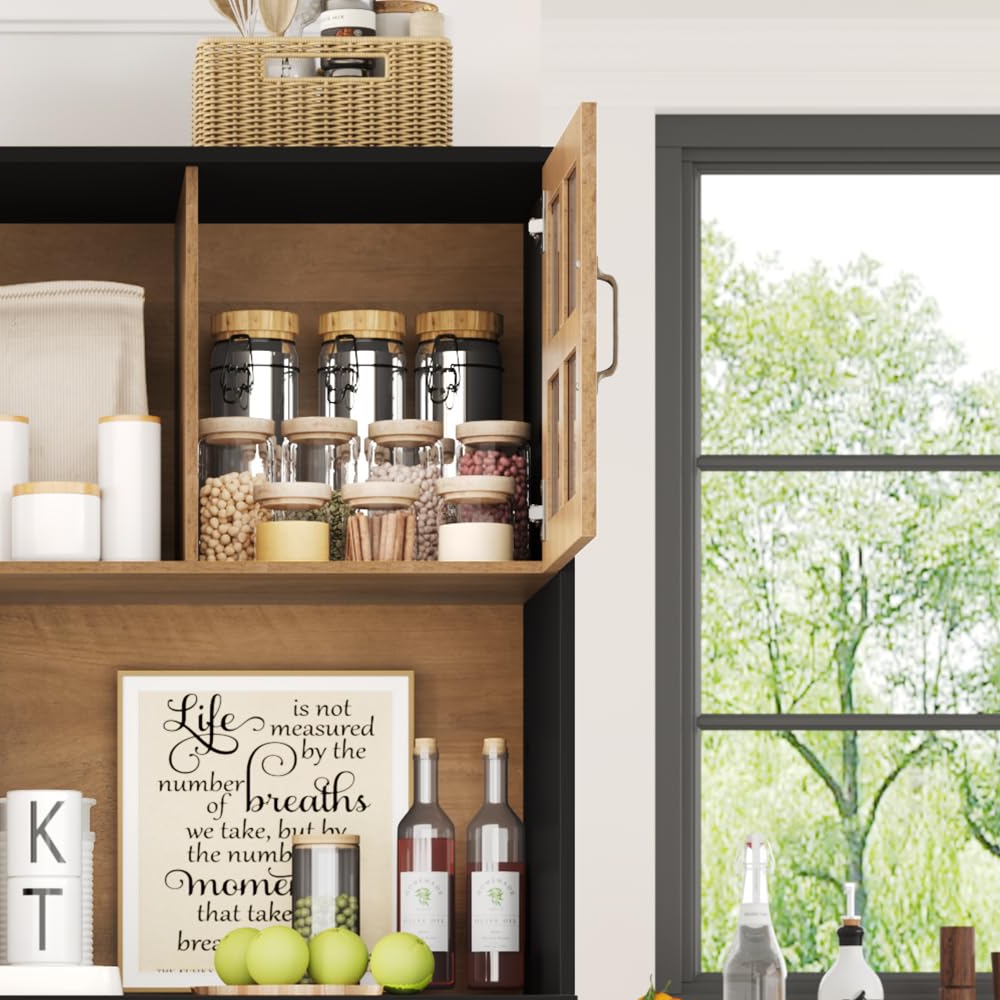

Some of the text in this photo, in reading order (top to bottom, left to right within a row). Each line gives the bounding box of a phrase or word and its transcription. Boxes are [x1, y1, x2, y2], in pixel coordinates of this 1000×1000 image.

[293, 699, 351, 716] is not
[163, 694, 265, 774] Life
[271, 715, 375, 736] measured
[301, 738, 366, 766] by the
[159, 771, 245, 792] number
[206, 742, 371, 820] of breaths
[30, 801, 66, 863] K
[186, 826, 214, 839] we
[221, 818, 271, 842] take,
[188, 842, 221, 863] the
[23, 888, 63, 951] T
[197, 901, 239, 922] that
